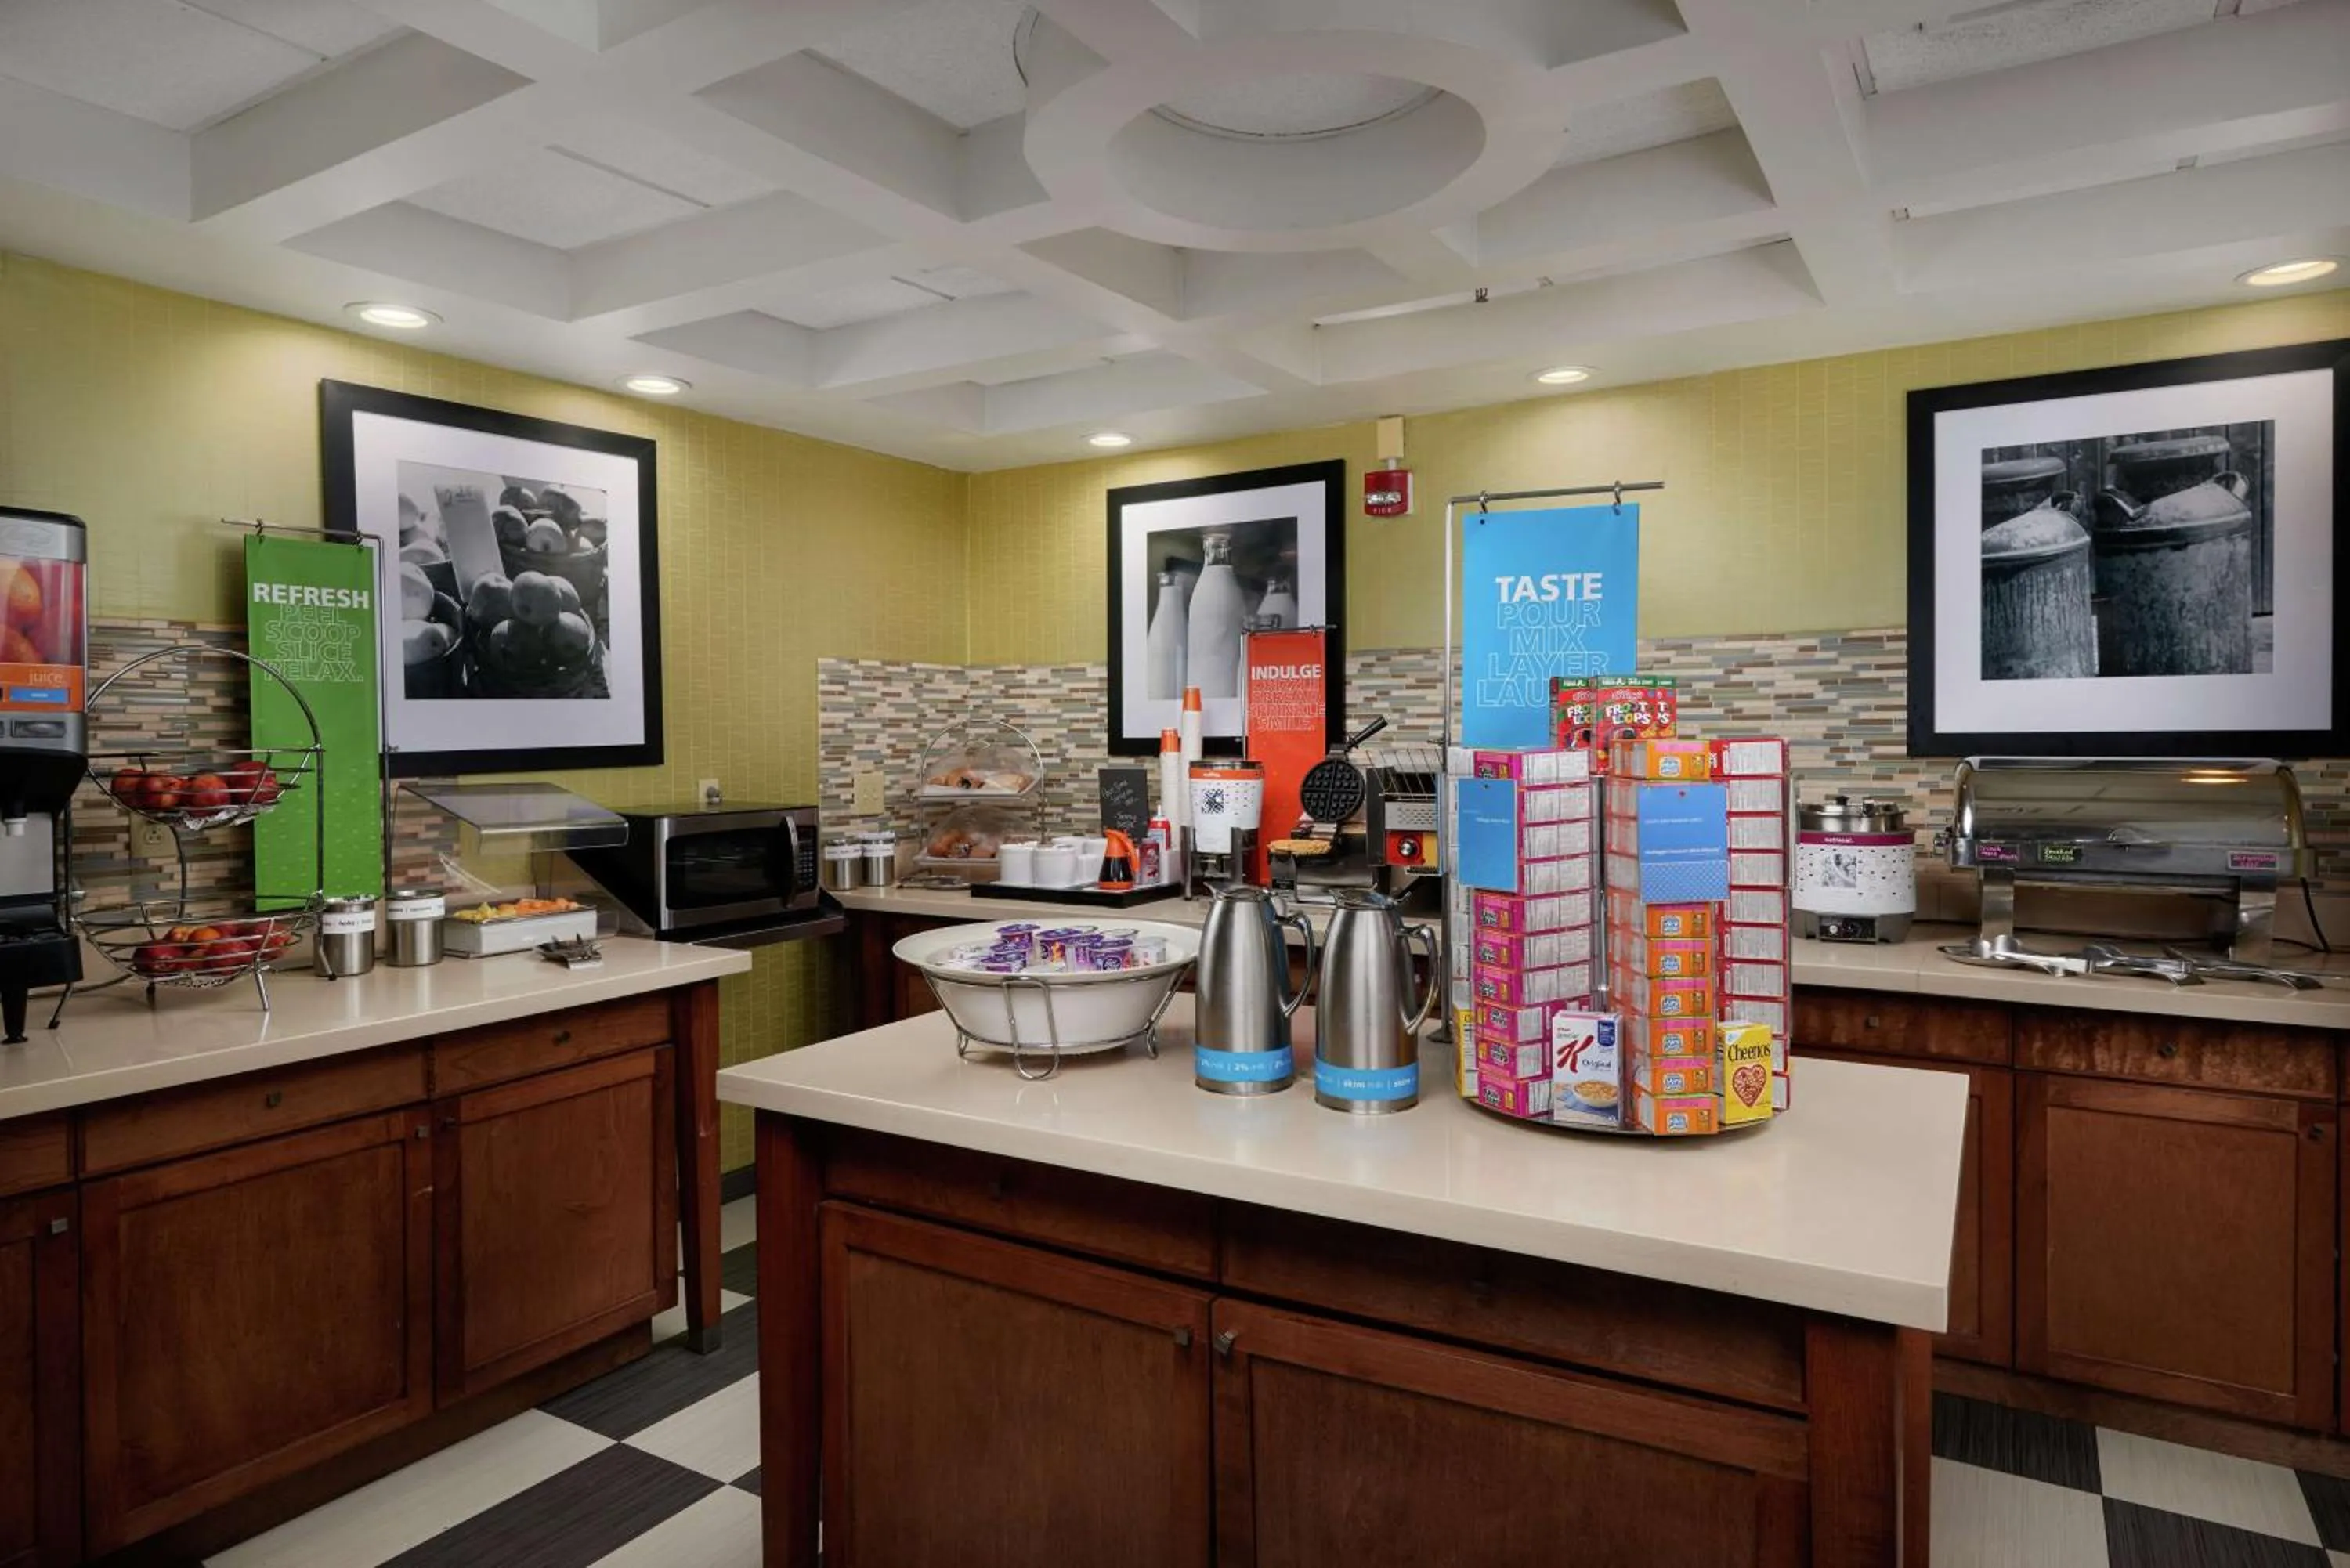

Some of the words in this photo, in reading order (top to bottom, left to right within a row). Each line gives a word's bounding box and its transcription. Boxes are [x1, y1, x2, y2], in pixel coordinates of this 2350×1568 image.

[253, 582, 369, 609] REFRESH
[1495, 573, 1603, 603] TASTE
[280, 602, 346, 623] PEEL
[1497, 598, 1600, 629] POUR
[265, 620, 361, 644] SCOOP
[1510, 625, 1587, 656] MIX
[276, 639, 353, 663] SLICE
[29, 670, 63, 686] juice
[1251, 663, 1321, 680] INDULGE
[1489, 651, 1610, 681] LAYER
[1606, 702, 1649, 717] FROOT
[1613, 712, 1652, 724] LOOPS
[1557, 1035, 1594, 1074] K
[1582, 1058, 1611, 1069] Original
[1728, 1043, 1771, 1062] Cheerios
